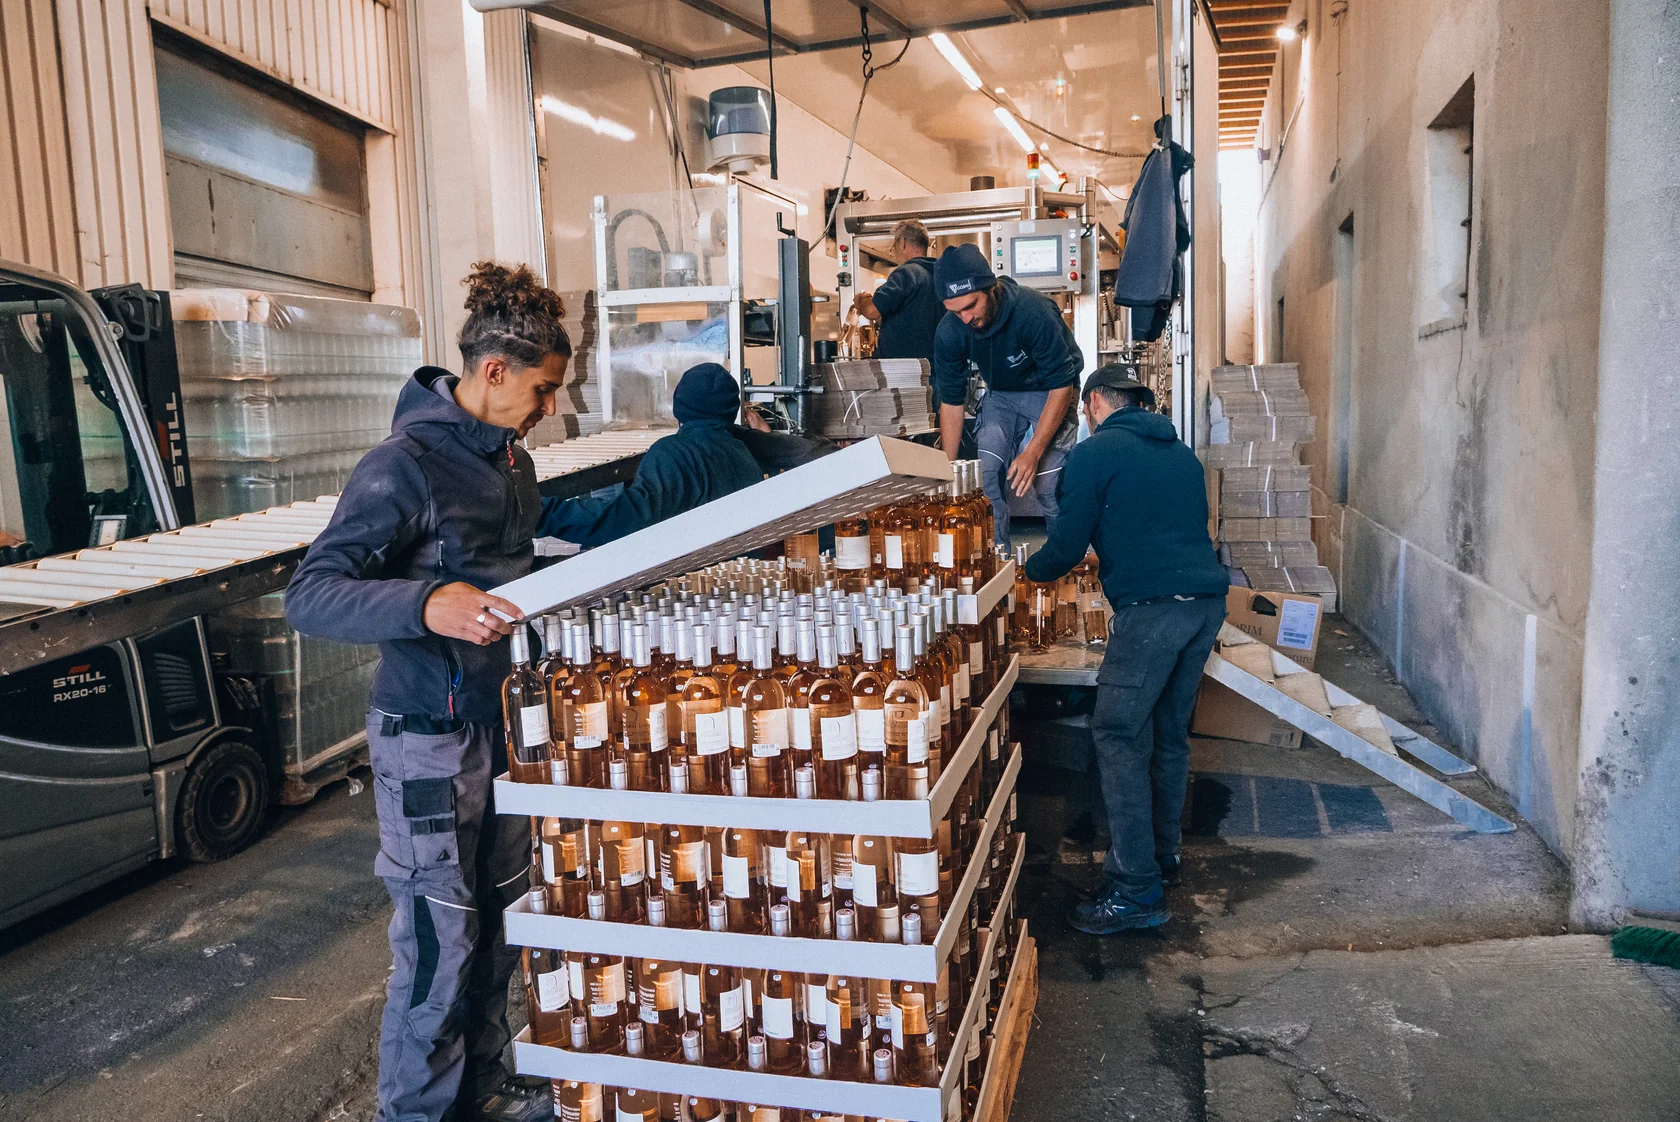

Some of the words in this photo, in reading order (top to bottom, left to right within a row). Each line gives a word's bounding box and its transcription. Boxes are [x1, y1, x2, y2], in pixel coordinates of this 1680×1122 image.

[166, 392, 186, 487] STILL
[1284, 652, 1313, 663] ature
[53, 671, 106, 688] STILL
[53, 685, 107, 702] RX20-16
